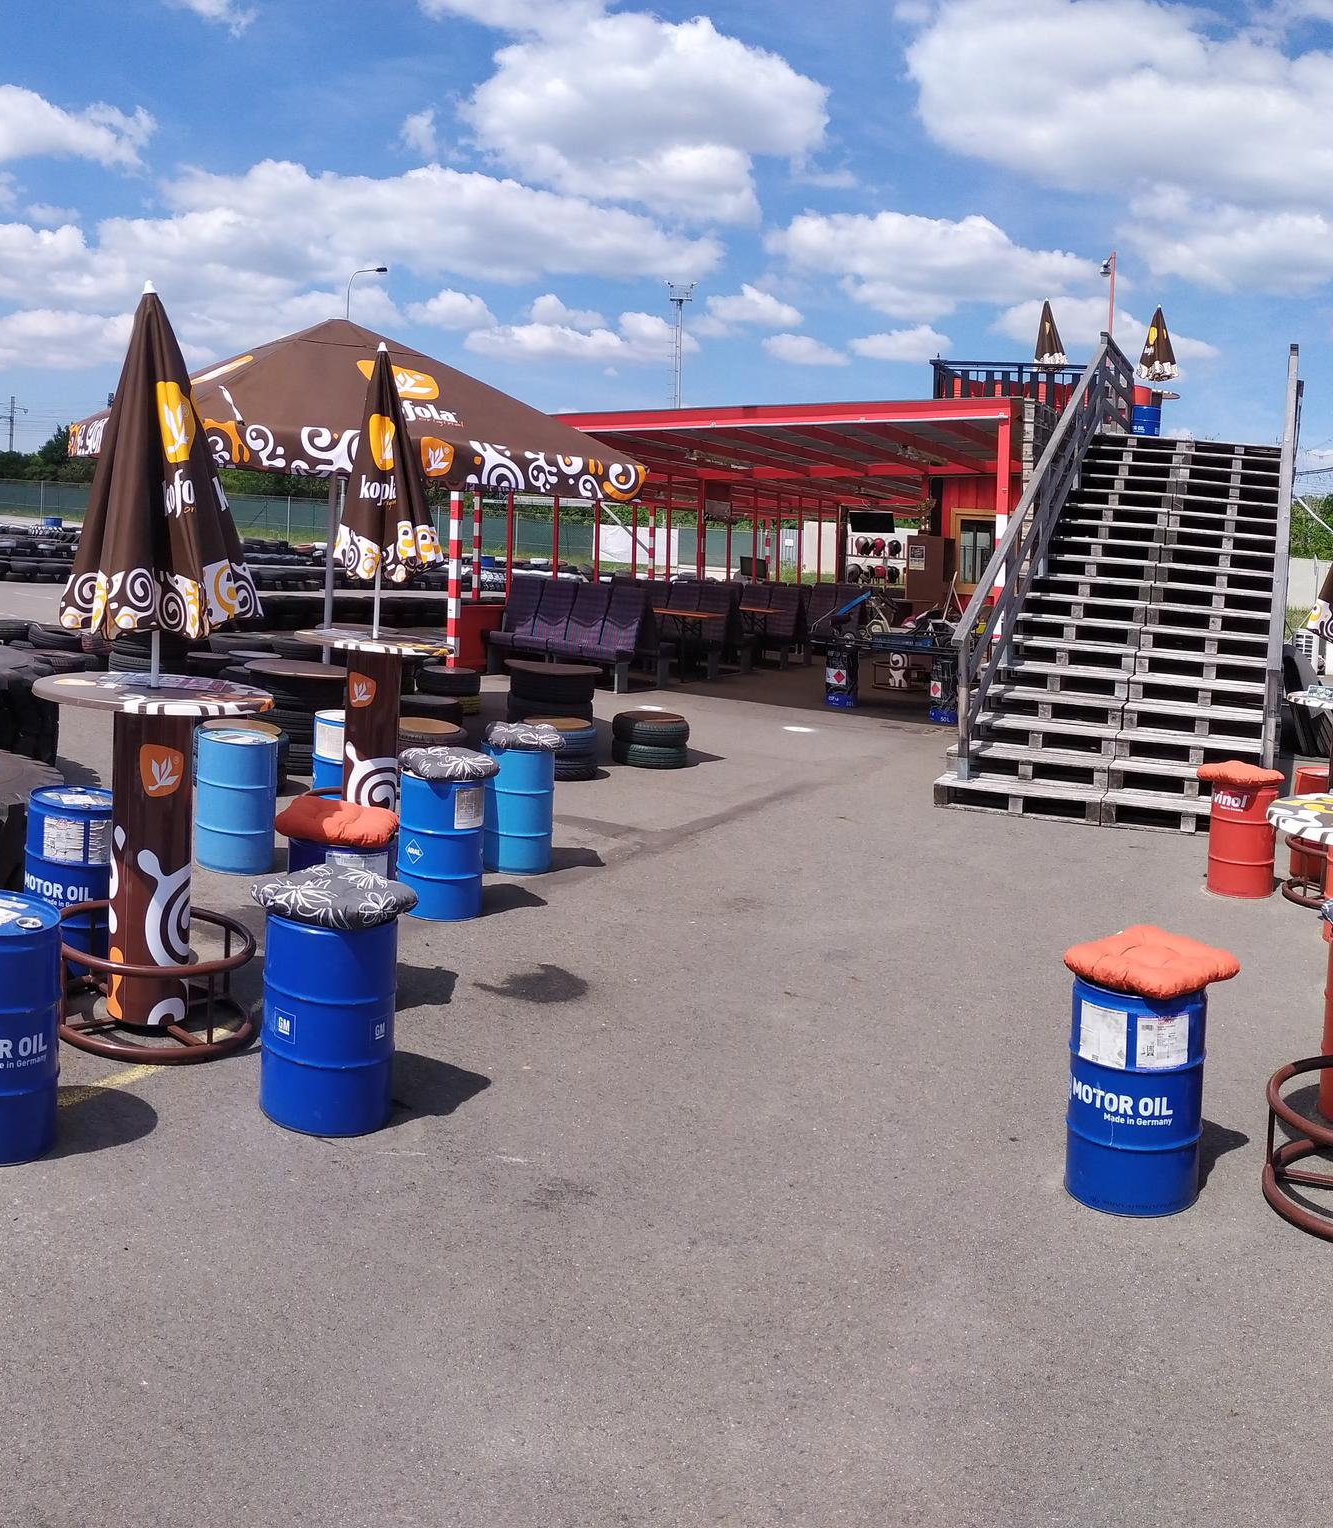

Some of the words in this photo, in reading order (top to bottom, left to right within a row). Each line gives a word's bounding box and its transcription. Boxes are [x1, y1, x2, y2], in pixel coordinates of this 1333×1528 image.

[402, 400, 458, 423] fola
[24, 870, 64, 899] MOTOR
[68, 885, 94, 902] OIL
[278, 1016, 290, 1032] GM
[374, 1022, 386, 1036] GM
[18, 1032, 48, 1057] OIL
[6, 1060, 15, 1069] in
[16, 1054, 48, 1068] Germany
[1073, 1076, 1134, 1115] MOTOR
[1138, 1096, 1174, 1117] OIL
[1103, 1112, 1125, 1125] Made
[1126, 1116, 1135, 1125] in
[1136, 1117, 1173, 1127] Germany
